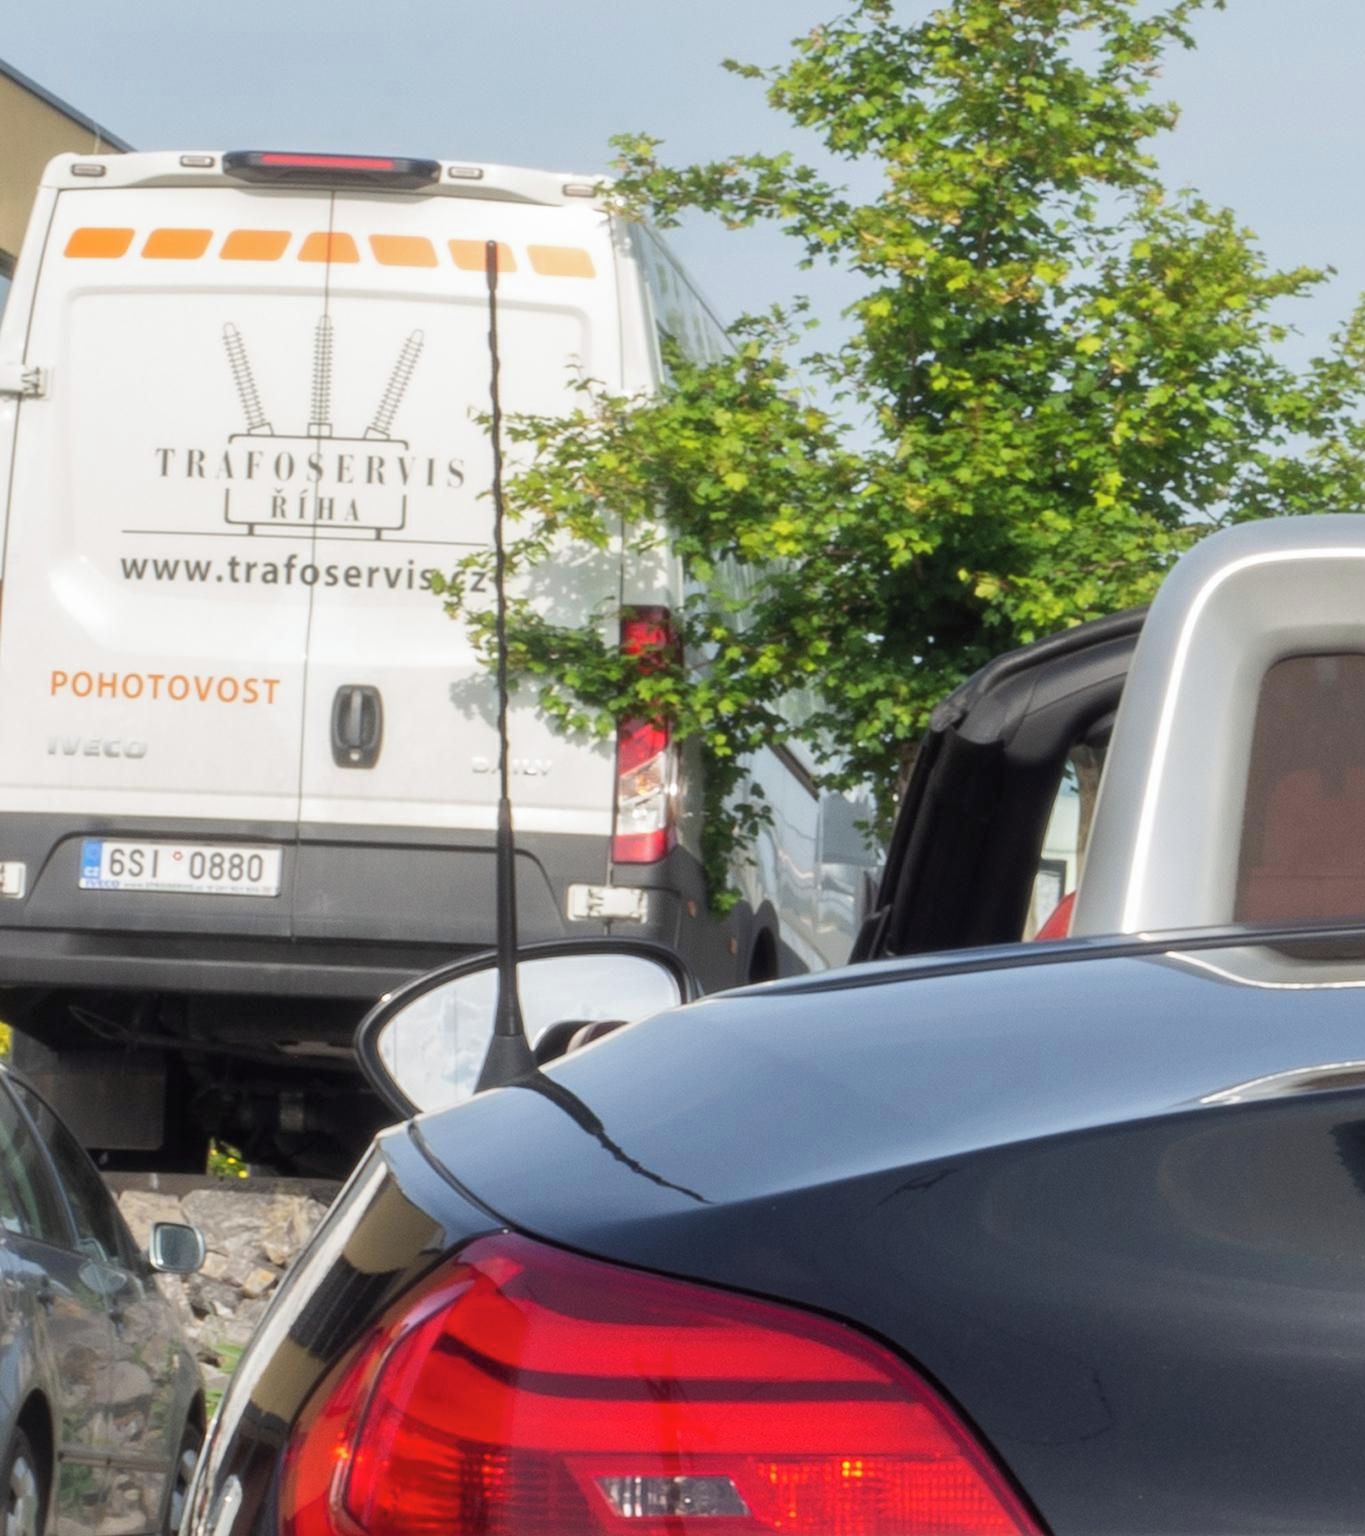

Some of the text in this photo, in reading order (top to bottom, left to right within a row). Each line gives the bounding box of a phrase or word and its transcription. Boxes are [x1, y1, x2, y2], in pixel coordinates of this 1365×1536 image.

[155, 447, 466, 489] TRAFOSERVIS
[271, 488, 361, 522] ŘÍHA
[120, 553, 487, 594] www.trafoserviscz
[50, 670, 281, 705] POHOTOVOST
[47, 735, 148, 760] IVECO
[109, 848, 160, 879] 6SI
[189, 850, 264, 883] 0880
